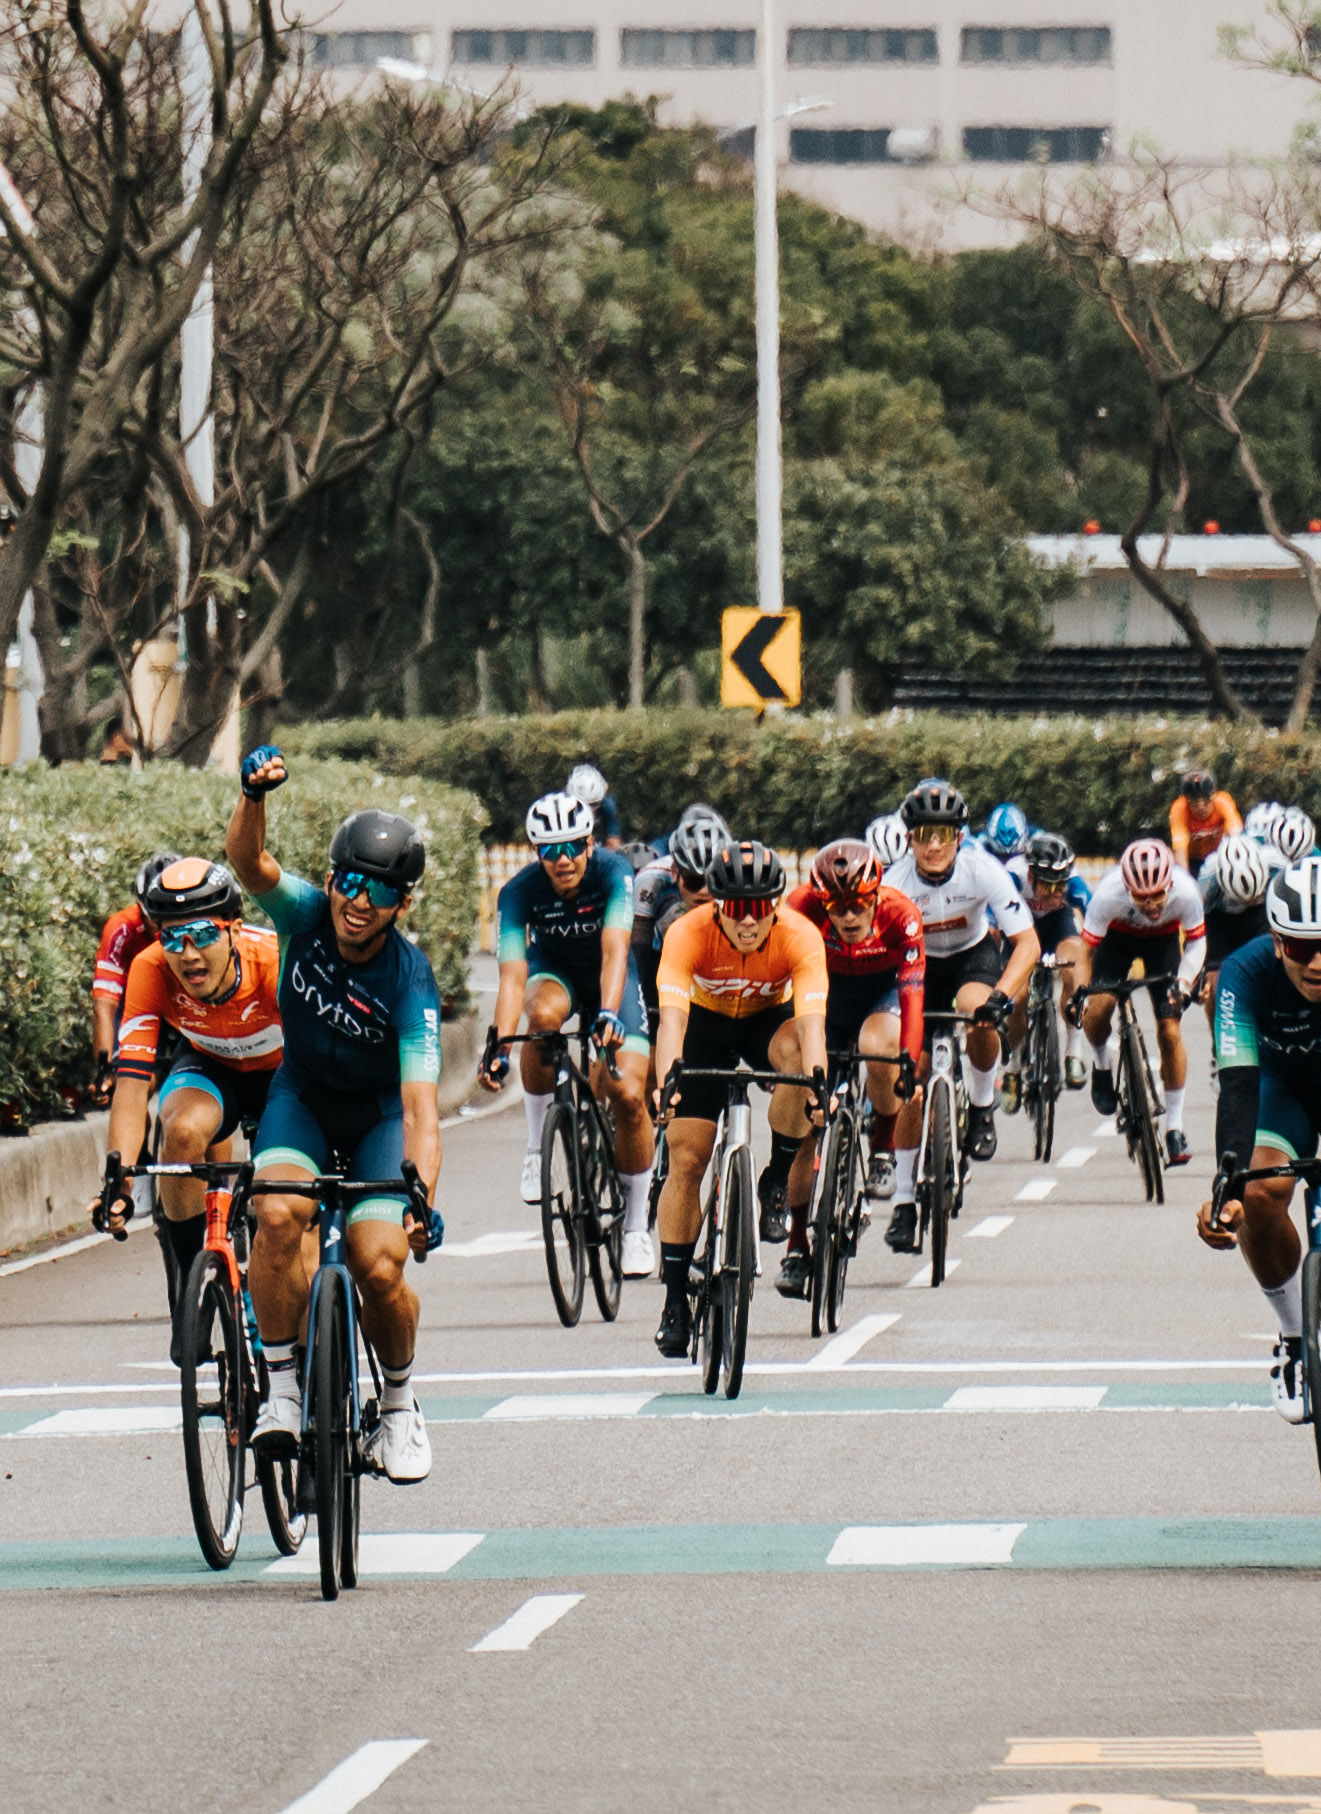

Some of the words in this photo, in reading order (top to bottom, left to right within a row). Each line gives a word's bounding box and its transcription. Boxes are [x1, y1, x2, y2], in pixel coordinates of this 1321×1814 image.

[292, 961, 385, 1044] bryton
[1220, 989, 1236, 1029] SWISS
[1220, 1030, 1237, 1056] DT
